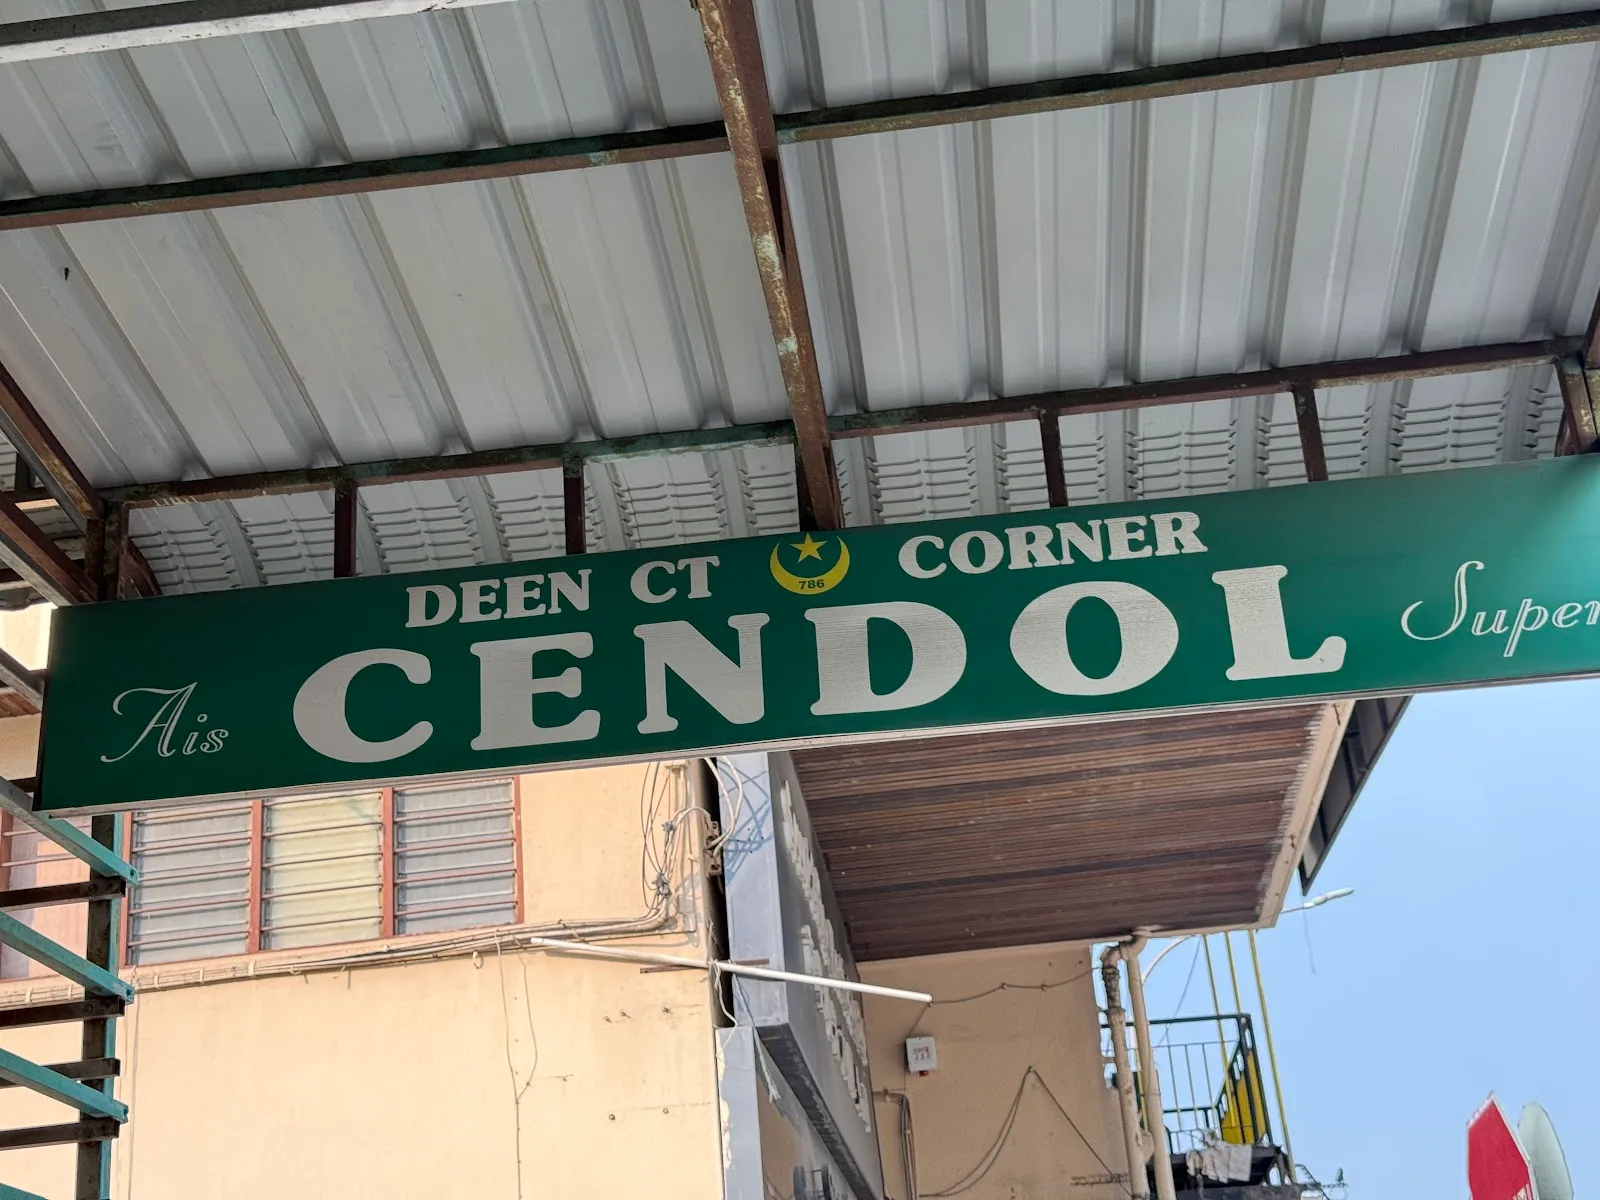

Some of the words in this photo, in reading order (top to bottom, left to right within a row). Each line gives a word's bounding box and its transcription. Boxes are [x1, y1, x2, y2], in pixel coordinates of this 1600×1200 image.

[406, 568, 592, 629] DEEN
[630, 555, 721, 604] CT
[898, 511, 1209, 579] CORNER
[797, 579, 825, 590] 786
[100, 682, 229, 764] Ais
[292, 564, 1348, 764] CENDOL
